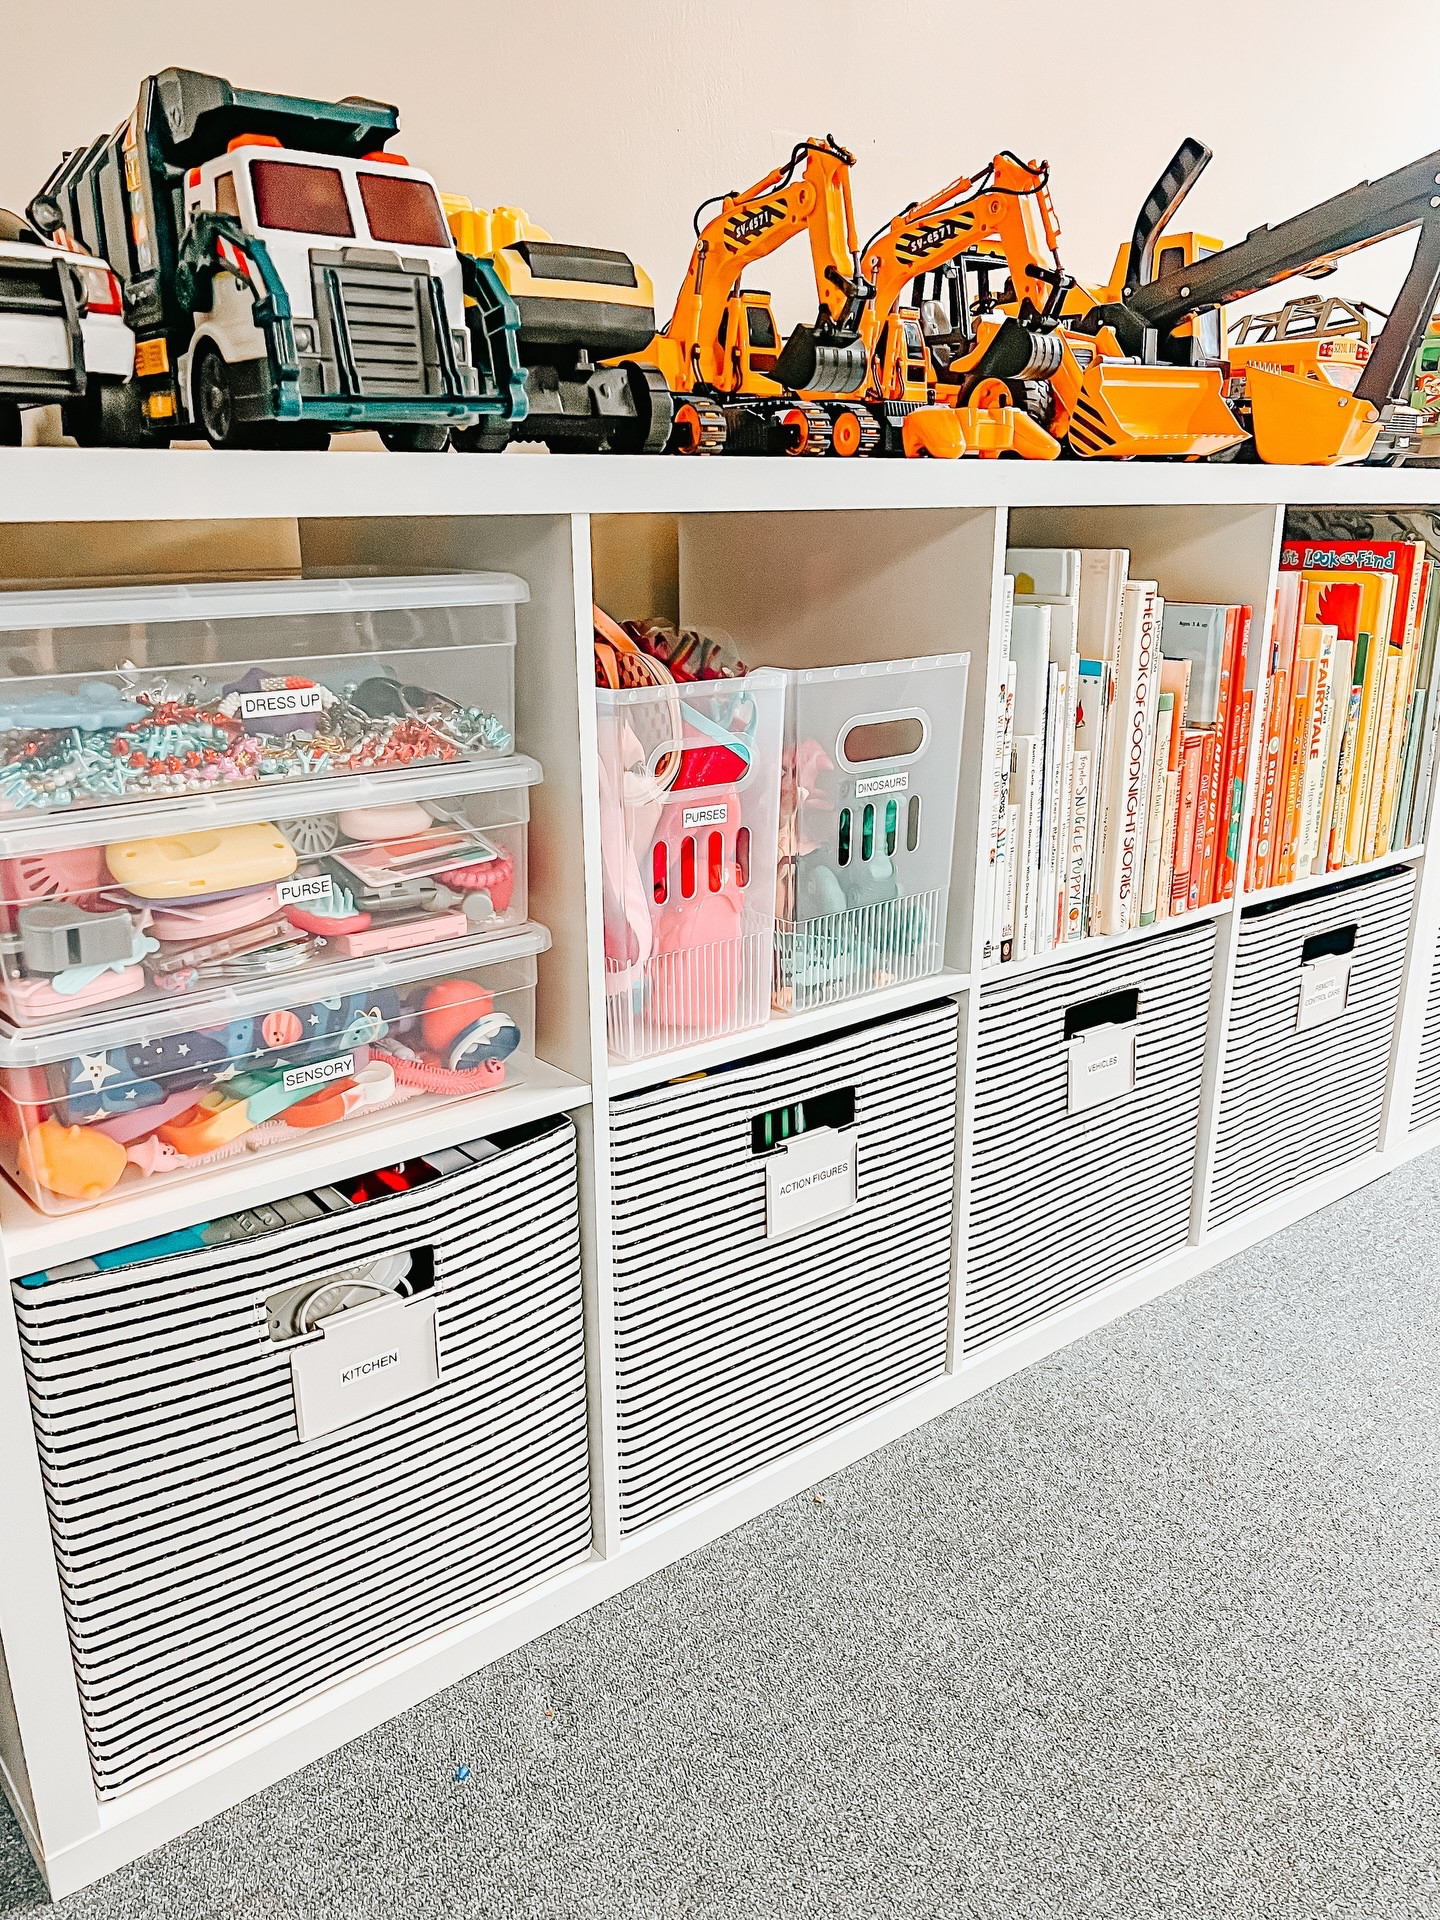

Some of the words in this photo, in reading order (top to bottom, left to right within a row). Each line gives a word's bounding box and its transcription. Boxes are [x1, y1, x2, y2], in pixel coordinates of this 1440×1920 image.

[1303, 548, 1340, 569] Look
[1356, 550, 1396, 570] Find
[1143, 590, 1156, 620] THE
[1137, 621, 1153, 681] BOOK
[1241, 618, 1251, 657] PEANUTS
[245, 695, 296, 713] DRESS
[300, 693, 320, 708] UP
[1135, 683, 1147, 707] OF
[1309, 658, 1330, 760] FAIRYTALE
[1324, 685, 1331, 703] My
[1381, 690, 1393, 721] WILL
[995, 714, 1004, 760] WELCOME
[1216, 711, 1225, 738] ALL
[1231, 715, 1240, 747] Charlie
[1239, 701, 1250, 744] Christmas
[1378, 722, 1390, 749] YOU
[1156, 740, 1166, 792] Storybook
[1210, 743, 1222, 799] REVVED
[1229, 749, 1237, 776] Brown
[1237, 745, 1246, 765] Wish
[858, 776, 907, 794] DINOSAURS
[1001, 771, 1009, 788] Dr.
[1125, 710, 1145, 834] GOODNIGHT
[1267, 759, 1277, 786] RED
[992, 781, 1000, 799] OUR
[998, 788, 1008, 820] Seuss's
[1223, 777, 1234, 821] Christmas
[1286, 767, 1298, 822] THANKFUL
[1368, 772, 1384, 833] SUNSHINE
[685, 808, 726, 824] PURSES
[991, 804, 999, 839] WORLD
[1072, 785, 1088, 853] SNUGGLE
[1154, 794, 1163, 820] Bible
[1208, 801, 1216, 821] UP
[1262, 790, 1274, 835] TRUCK
[996, 827, 1007, 864] ABC
[1069, 857, 1084, 907] PUPPY!
[1120, 837, 1135, 900] STORIES
[281, 880, 330, 900] PURSE
[1005, 875, 1013, 911] Caterpillar
[286, 1059, 352, 1087] SENSORY
[1087, 1056, 1118, 1073] VEHICLES
[780, 1177, 811, 1196] ACTION
[812, 1162, 848, 1184] FIGURES
[342, 1351, 398, 1383] KITCHEN
